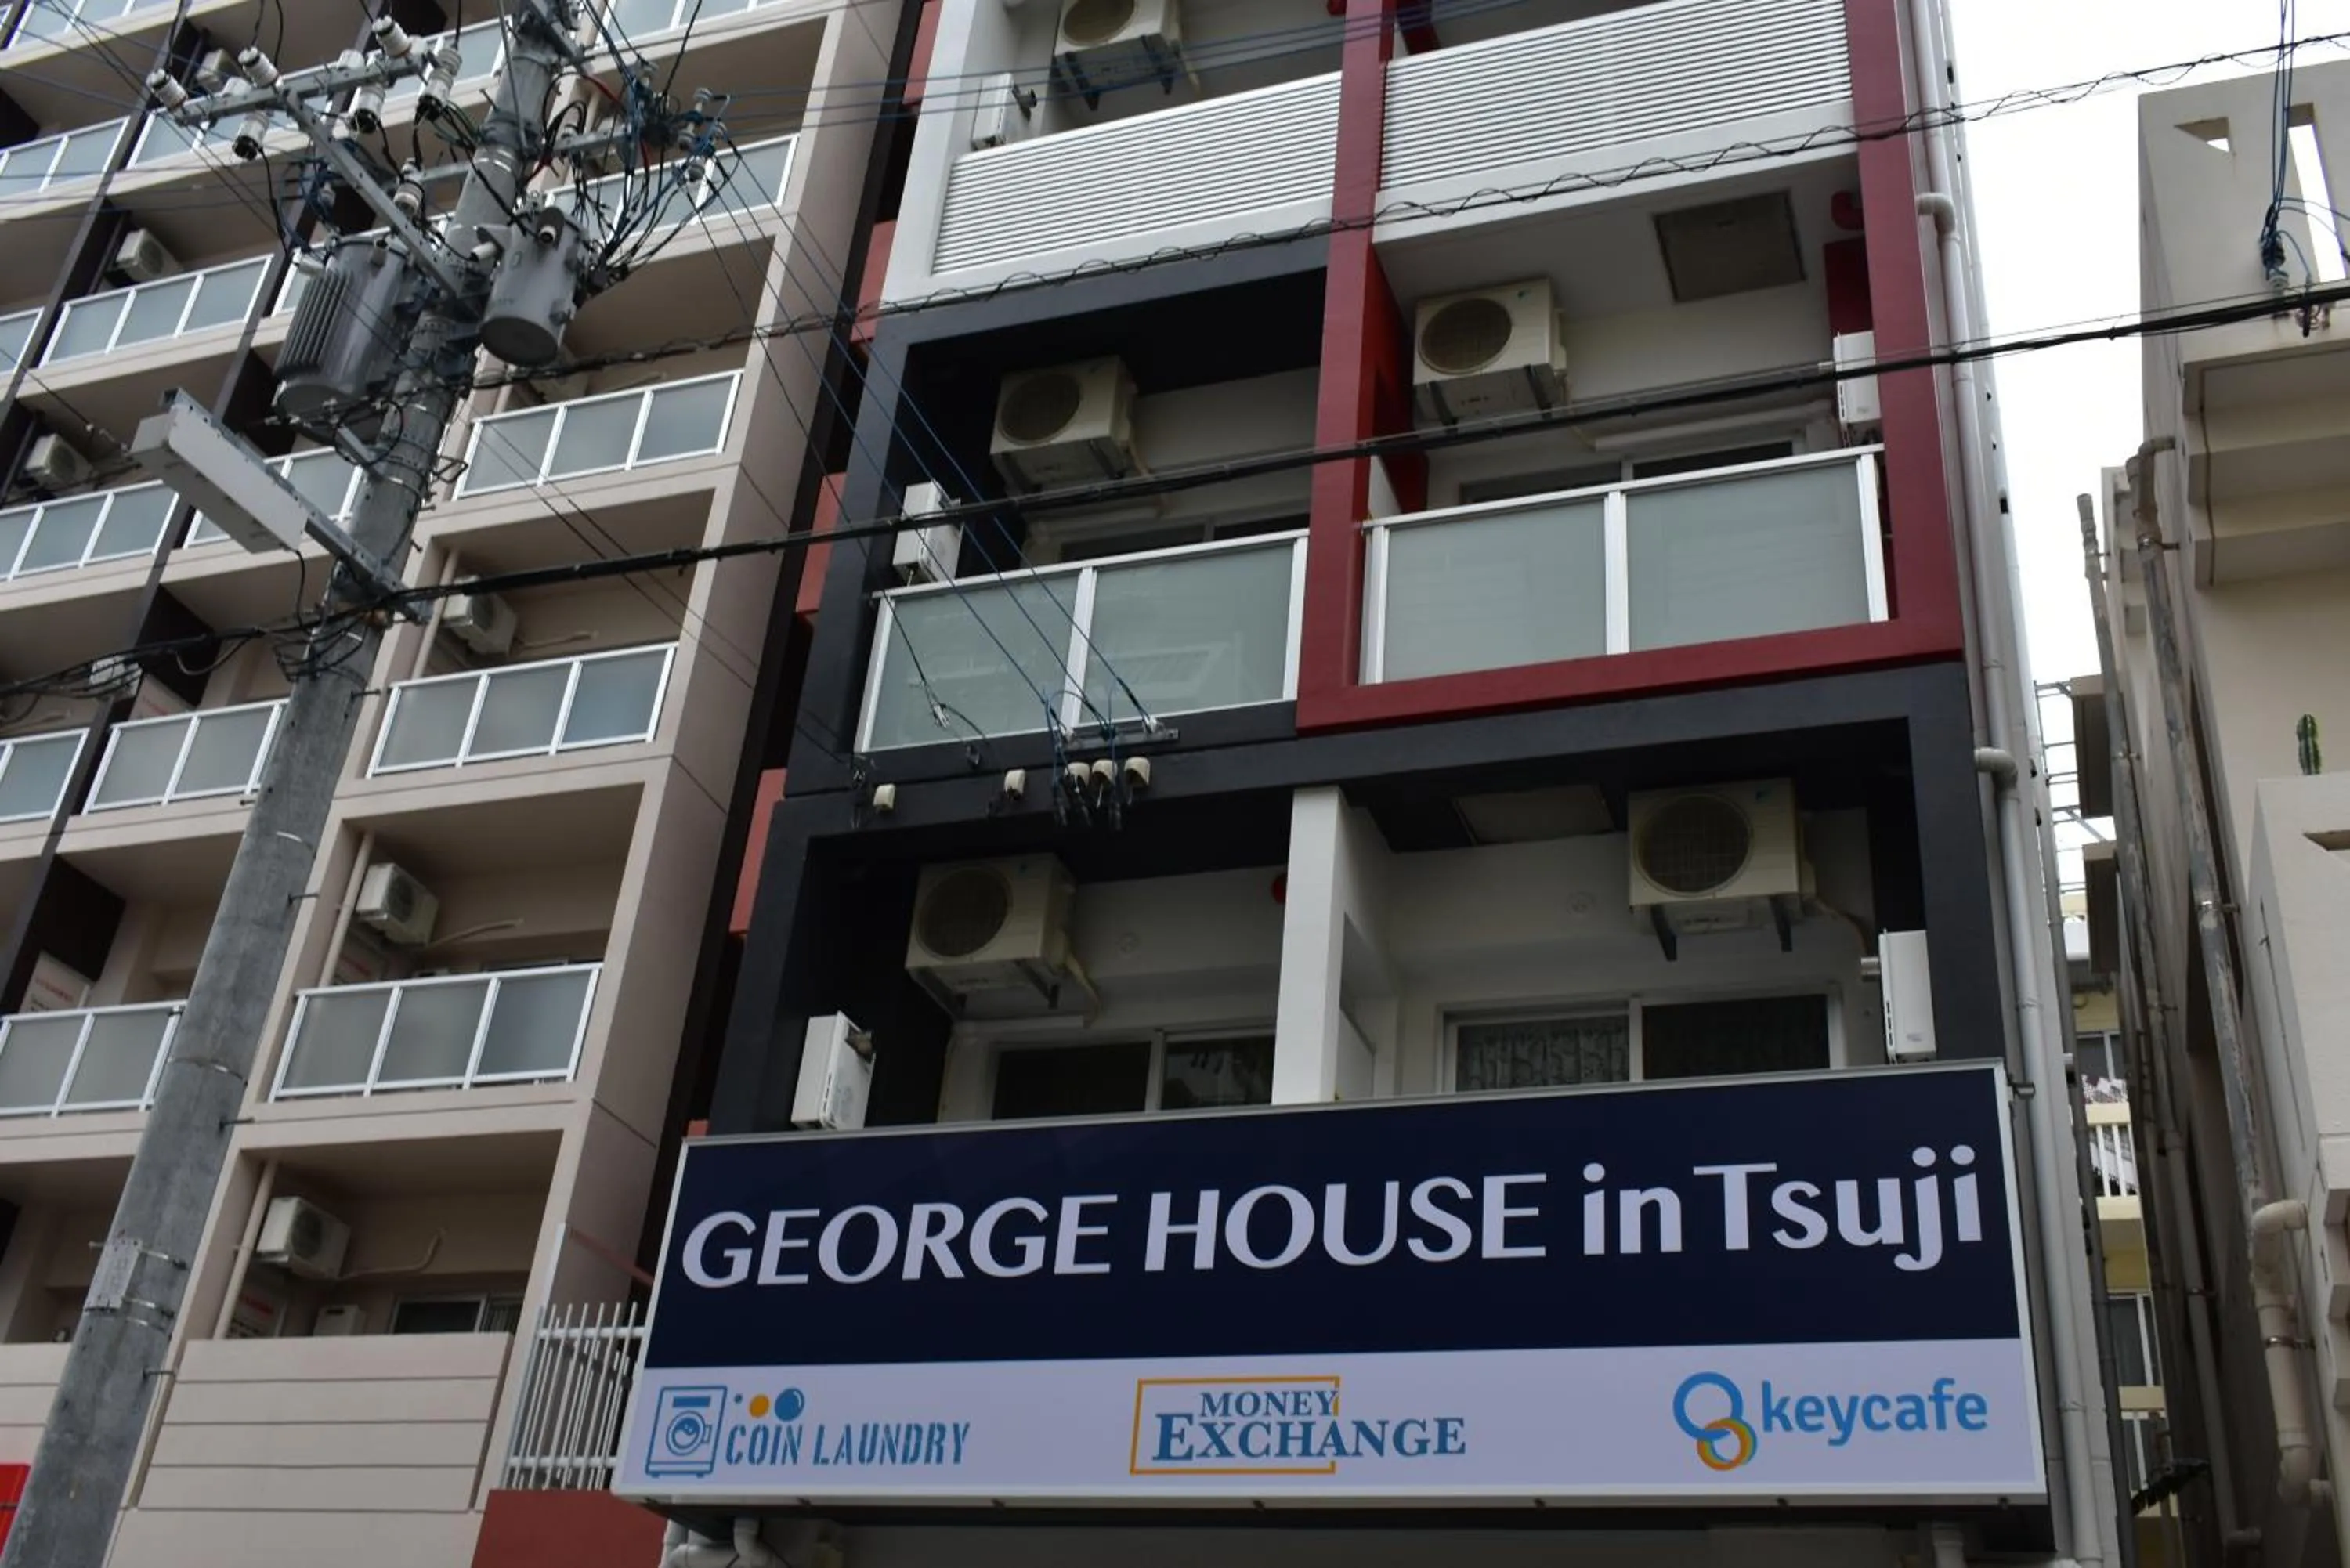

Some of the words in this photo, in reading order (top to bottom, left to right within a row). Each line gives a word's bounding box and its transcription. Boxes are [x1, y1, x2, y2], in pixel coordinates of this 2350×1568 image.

[682, 1194, 1119, 1288] GEORGE
[1144, 1173, 1548, 1272] HOUSE
[1582, 1162, 1683, 1255] in
[1692, 1145, 1983, 1272] Tsuji
[1198, 1389, 1340, 1419] MONEY
[1760, 1377, 1990, 1448] keycafe
[724, 1422, 804, 1467] COIN
[811, 1421, 971, 1467] LAUNDRY
[1151, 1412, 1467, 1463] EXCHANGE
